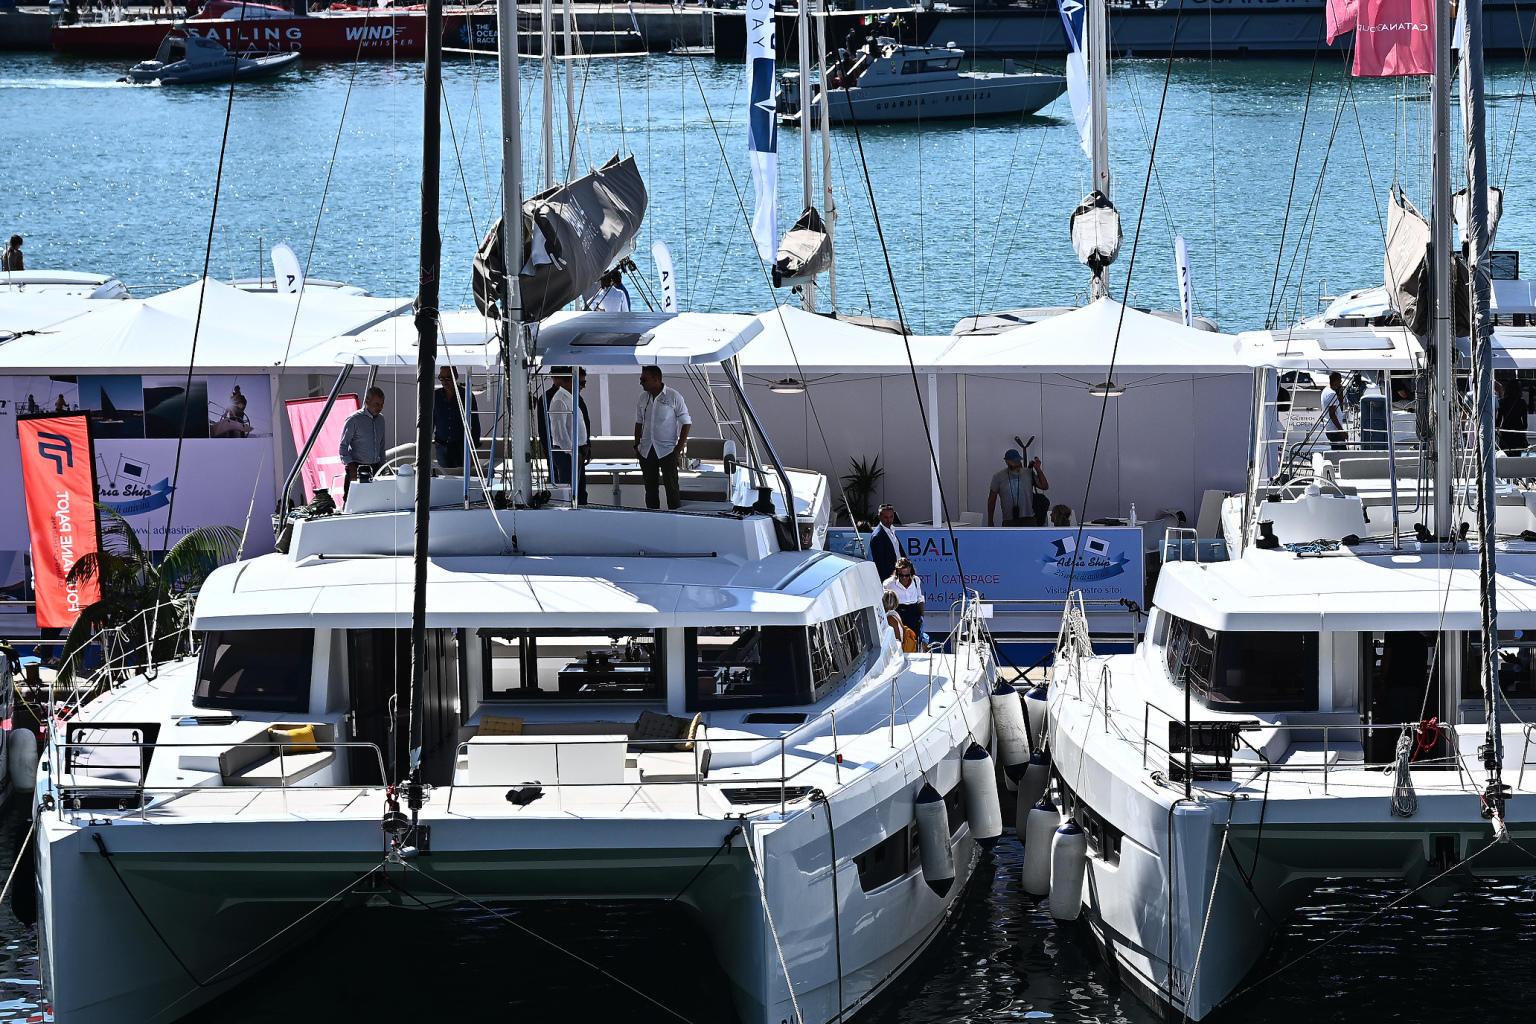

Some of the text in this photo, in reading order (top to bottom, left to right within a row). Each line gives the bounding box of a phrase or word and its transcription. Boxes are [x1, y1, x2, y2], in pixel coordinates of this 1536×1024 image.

[345, 25, 395, 41] WIND
[476, 23, 490, 31] THE
[188, 27, 302, 40] SAILING
[476, 37, 496, 45] RACE
[122, 484, 152, 500] Ship
[907, 537, 959, 556] BALI
[1087, 556, 1111, 568] Ship
[941, 574, 1000, 584] CATSPACE
[1045, 586, 1066, 594] Visita
